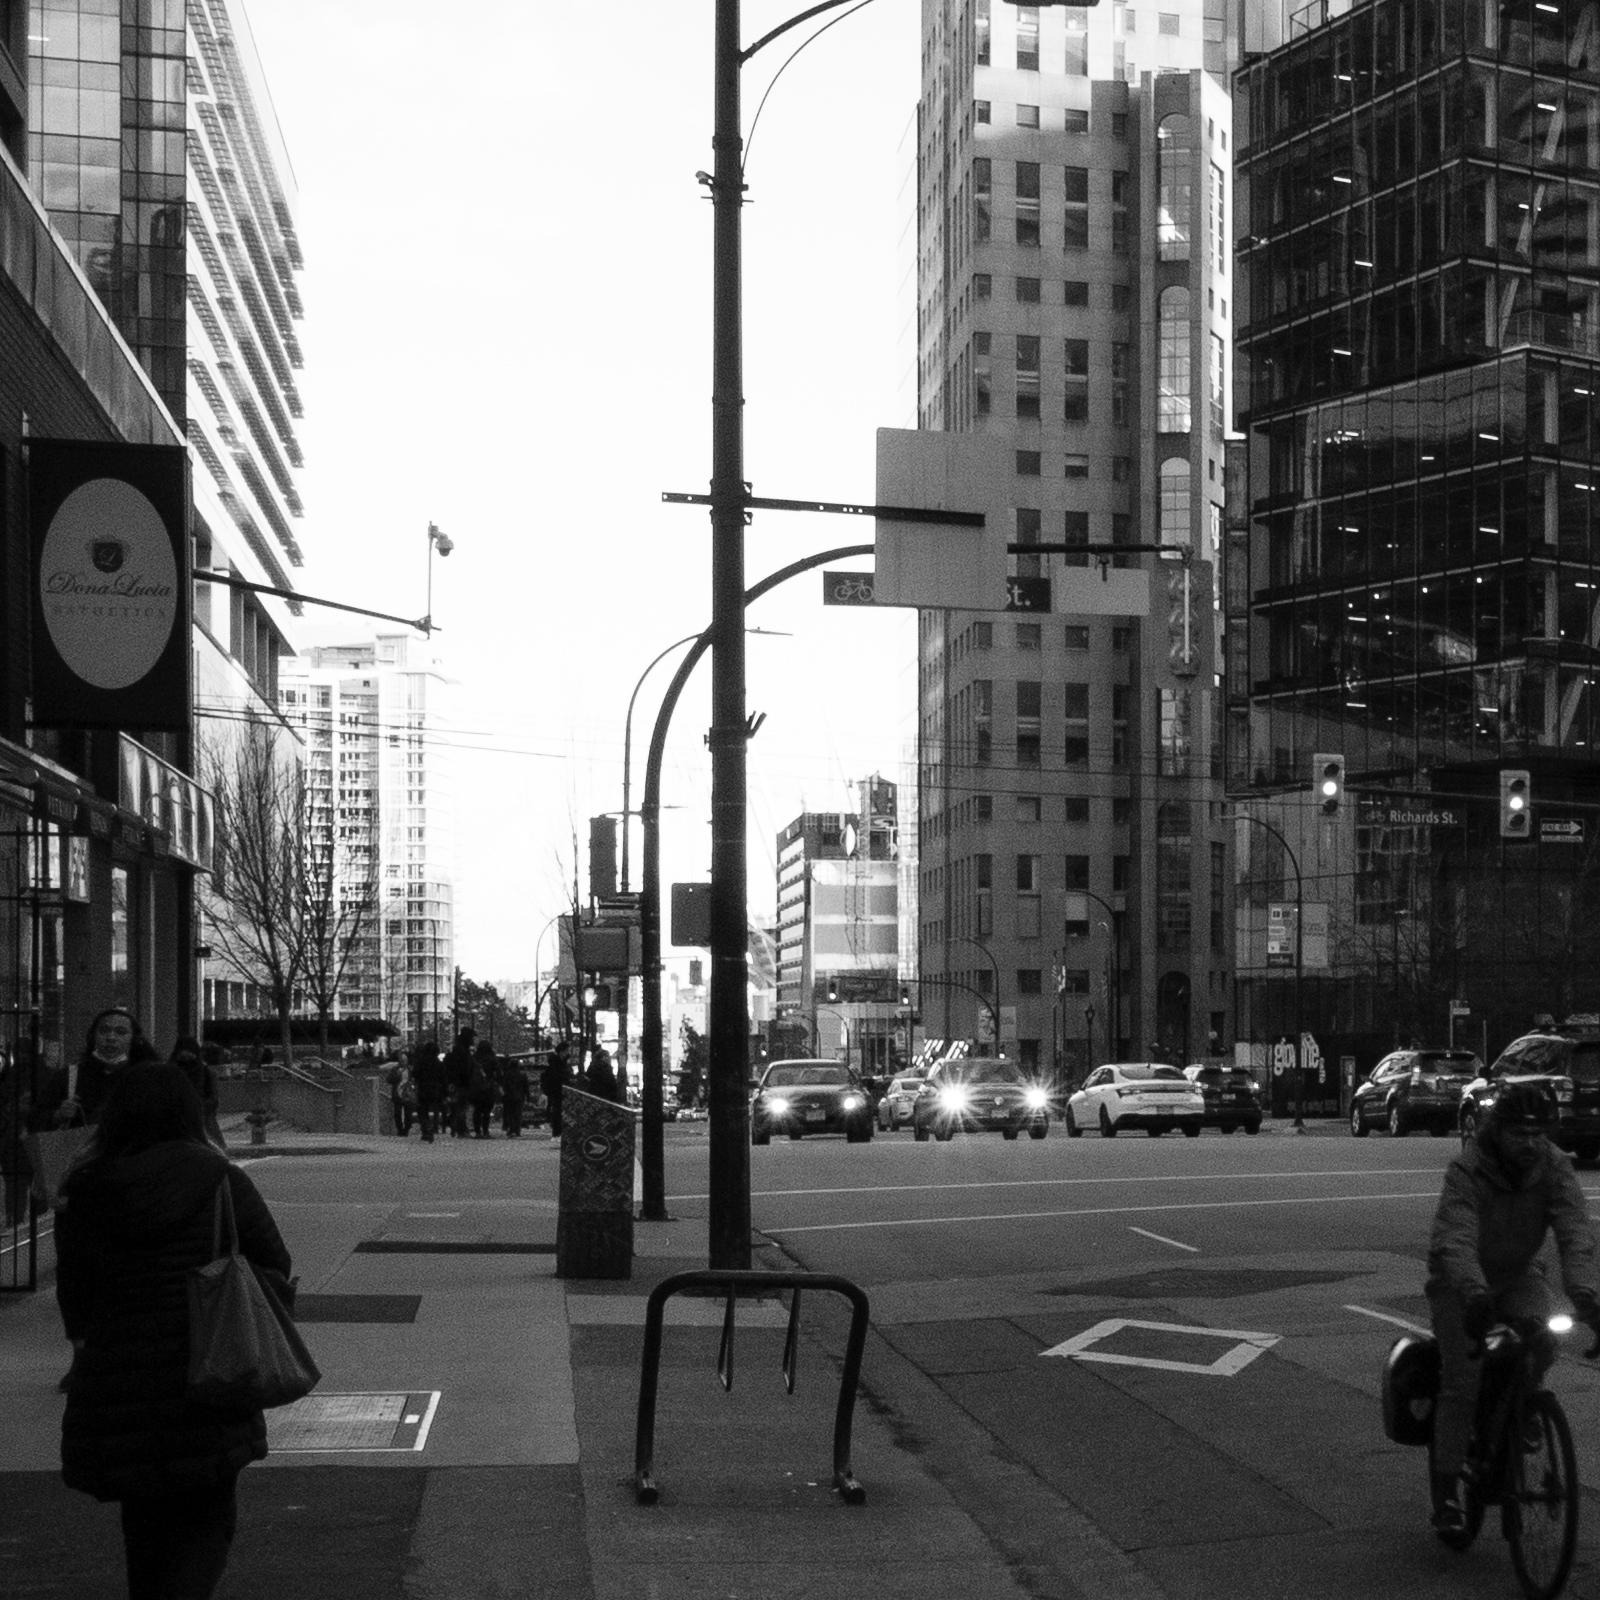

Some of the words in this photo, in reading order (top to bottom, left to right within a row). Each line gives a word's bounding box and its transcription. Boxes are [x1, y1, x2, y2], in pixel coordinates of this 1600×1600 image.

[45, 571, 110, 595] Dona
[113, 573, 171, 598] Lucia
[1390, 810, 1440, 824] Richards
[1441, 811, 1458, 824] St.
[1274, 1036, 1320, 1077] giovne
